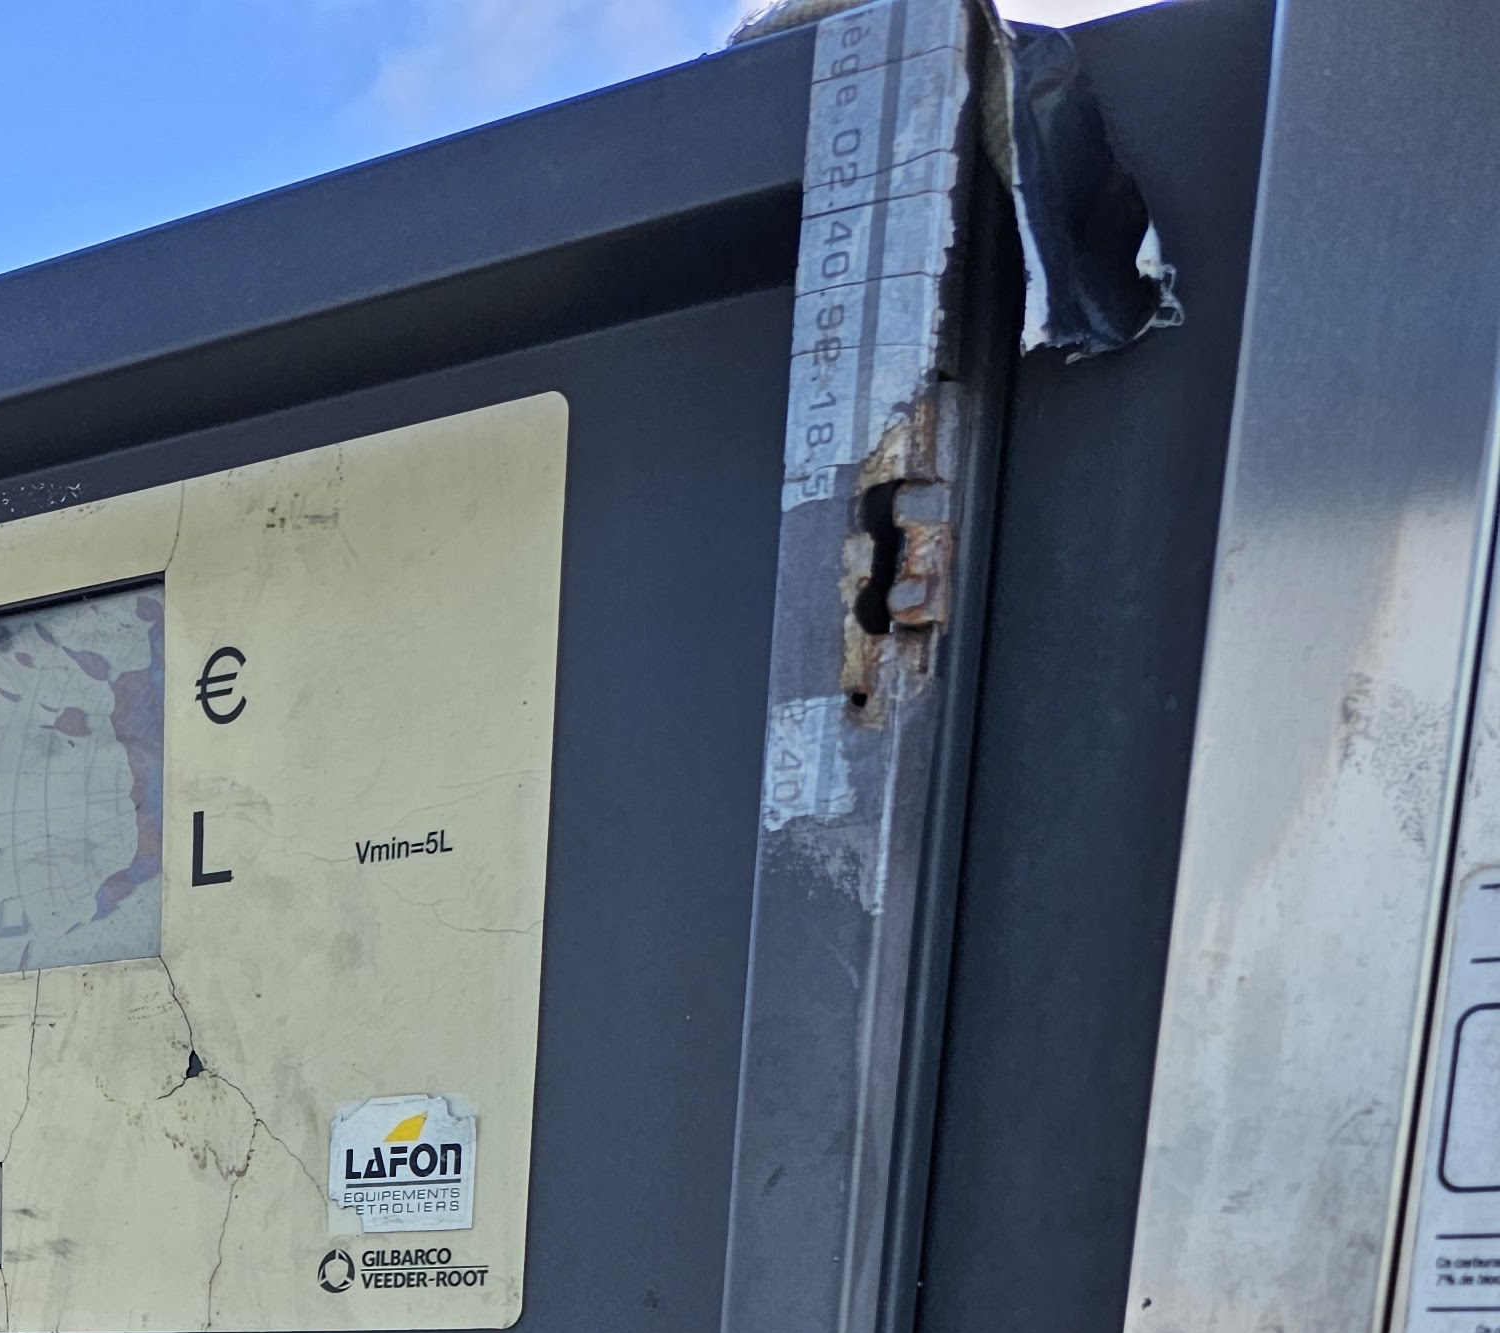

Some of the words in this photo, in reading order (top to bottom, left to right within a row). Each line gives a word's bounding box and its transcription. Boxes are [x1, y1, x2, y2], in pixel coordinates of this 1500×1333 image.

[194, 646, 247, 725] €
[191, 810, 234, 888] L
[355, 829, 453, 865] Vmin=5L
[345, 1143, 463, 1180] LAFON
[344, 1187, 461, 1204] EQUIPEMENTS
[355, 1200, 461, 1216] ETROLIERS
[361, 1248, 452, 1267] GILBARCO
[360, 1269, 490, 1290] VEEDER-ROOT
